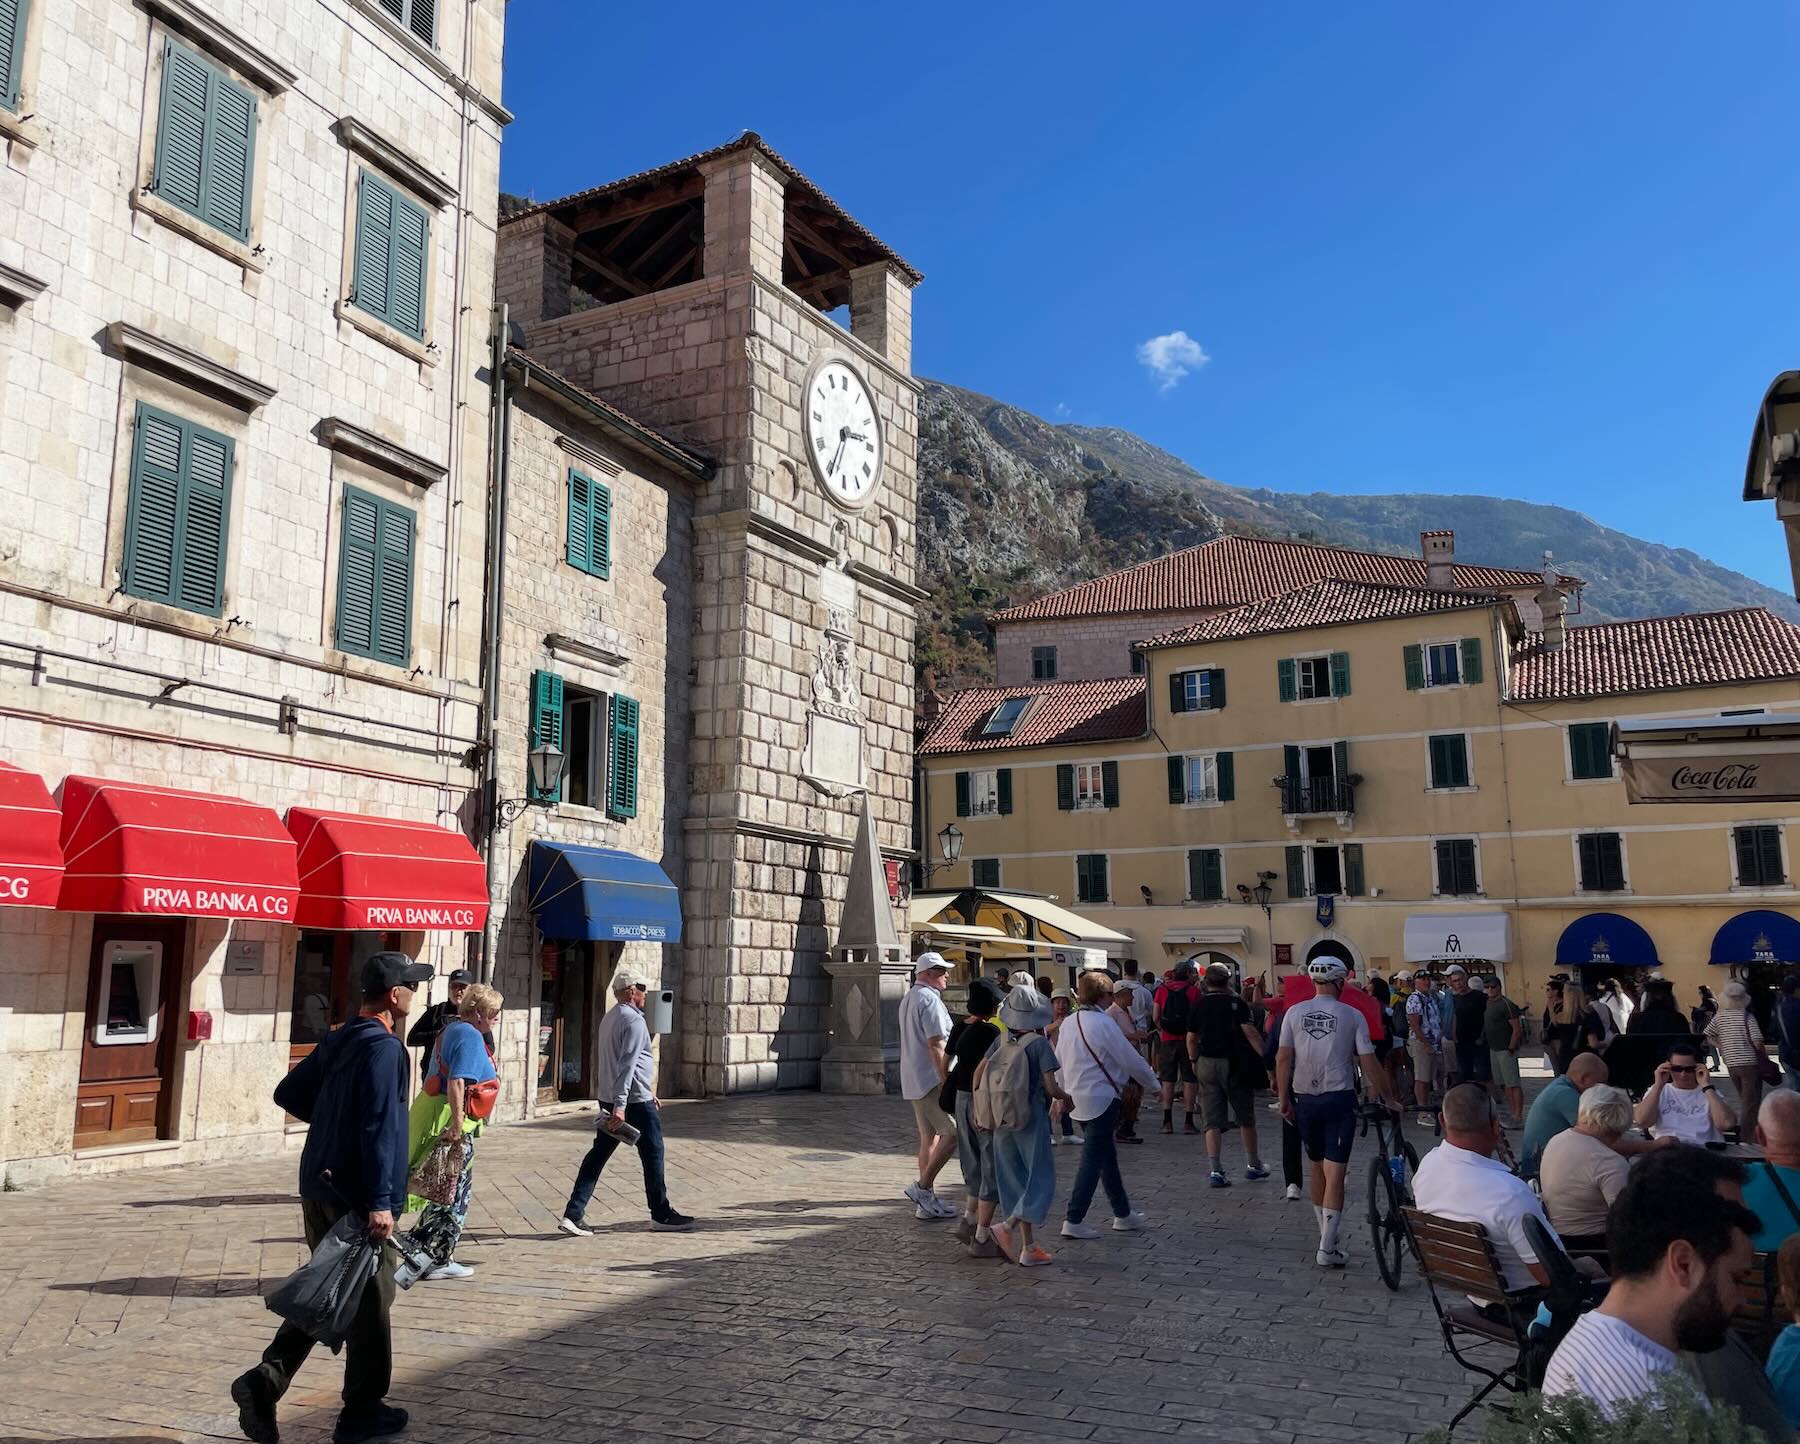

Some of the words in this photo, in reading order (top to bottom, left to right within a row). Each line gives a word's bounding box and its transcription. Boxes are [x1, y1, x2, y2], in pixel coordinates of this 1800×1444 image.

[1671, 764, 1760, 790] Coca-Cola
[143, 887, 192, 909] PRVA
[195, 890, 259, 913] BANKA
[262, 896, 289, 915] CG
[366, 907, 404, 924] PRVA
[405, 908, 453, 925] BANKA
[454, 910, 474, 926] CG
[612, 926, 641, 936] TOBACCO
[647, 927, 667, 937] PRESS
